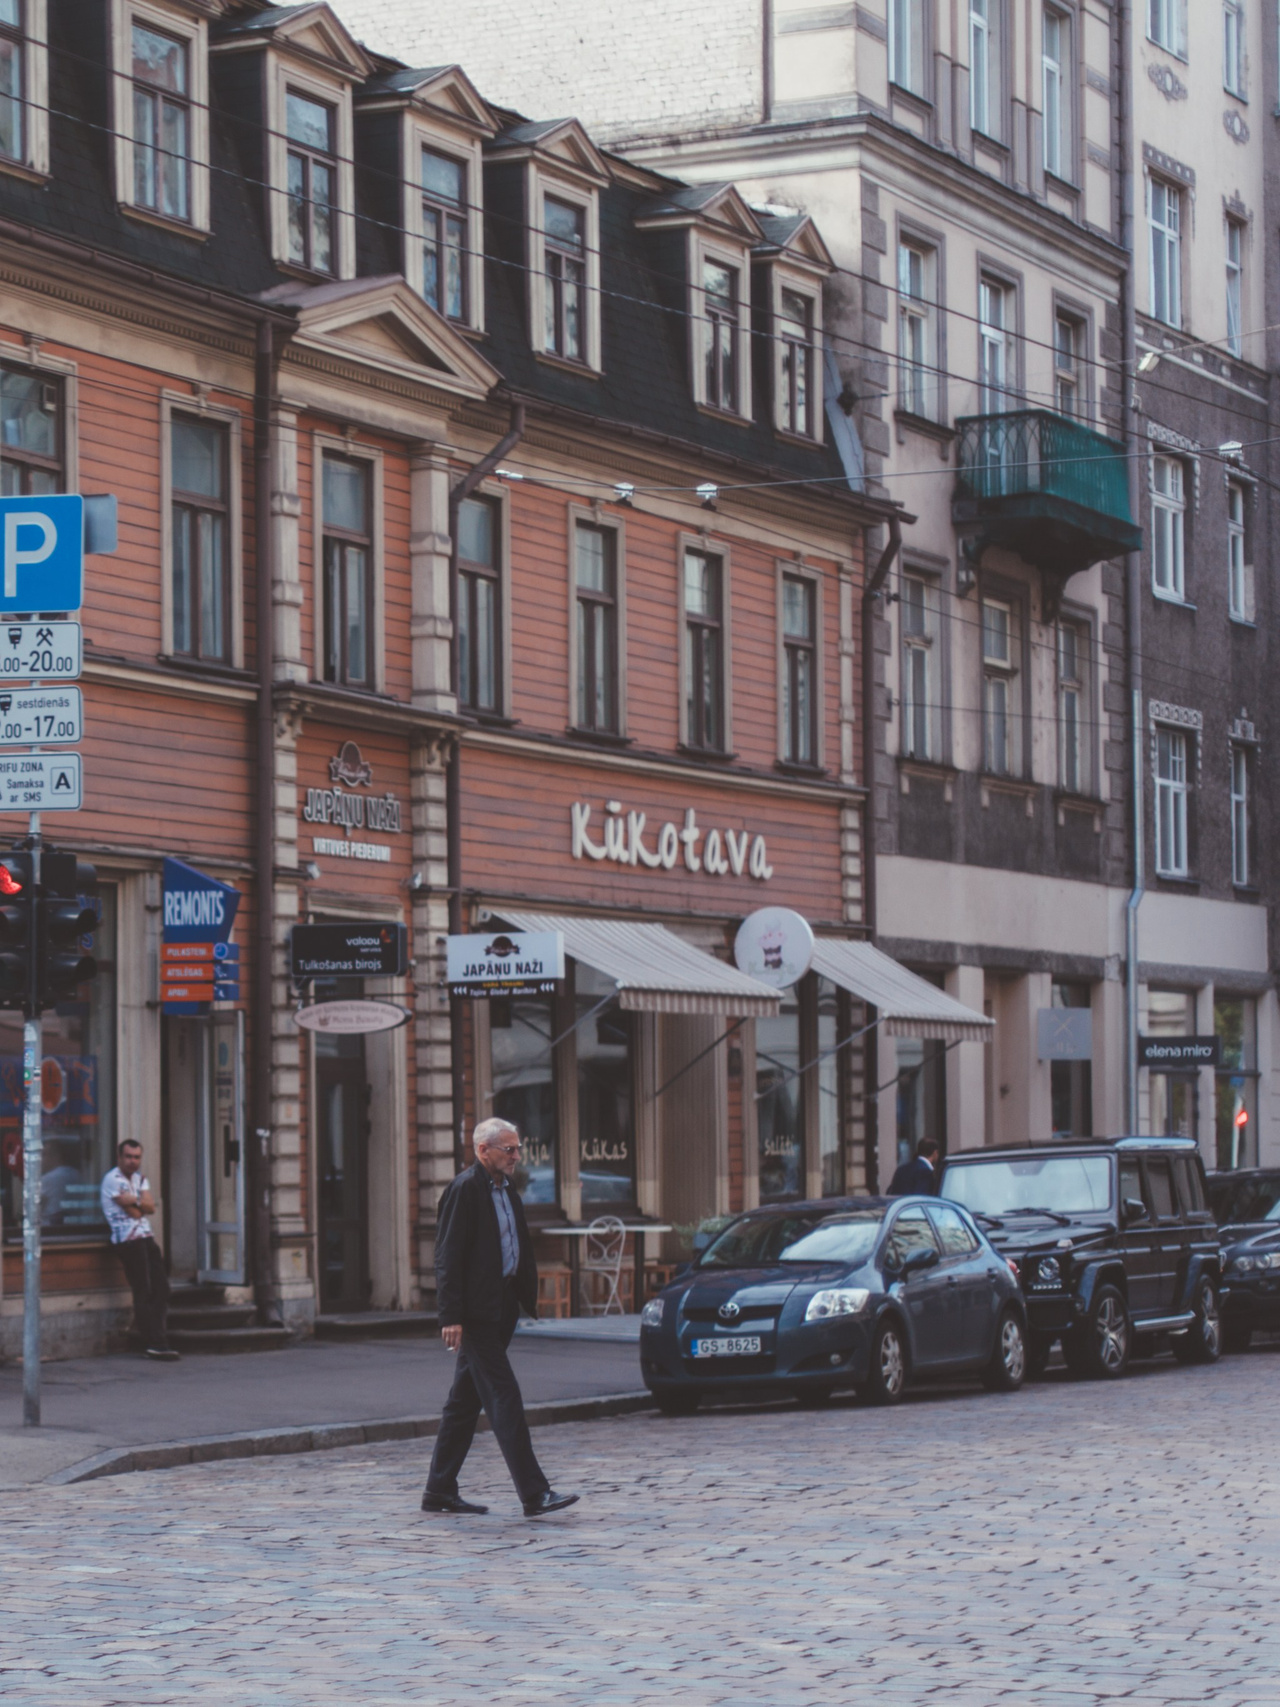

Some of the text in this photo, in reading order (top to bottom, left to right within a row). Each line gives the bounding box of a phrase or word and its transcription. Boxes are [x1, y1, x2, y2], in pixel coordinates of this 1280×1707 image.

[4, 512, 58, 598] P
[16, 697, 71, 710] sestdienās
[20, 762, 44, 773] ZONA
[6, 778, 45, 790] Samaksa
[55, 772, 71, 790] A
[9, 792, 42, 803] ar SMS
[312, 837, 350, 858] VIRTUVES
[164, 890, 224, 926] REMONTS
[298, 958, 382, 971] Tulkošanas birojs
[1144, 1043, 1181, 1058] elena
